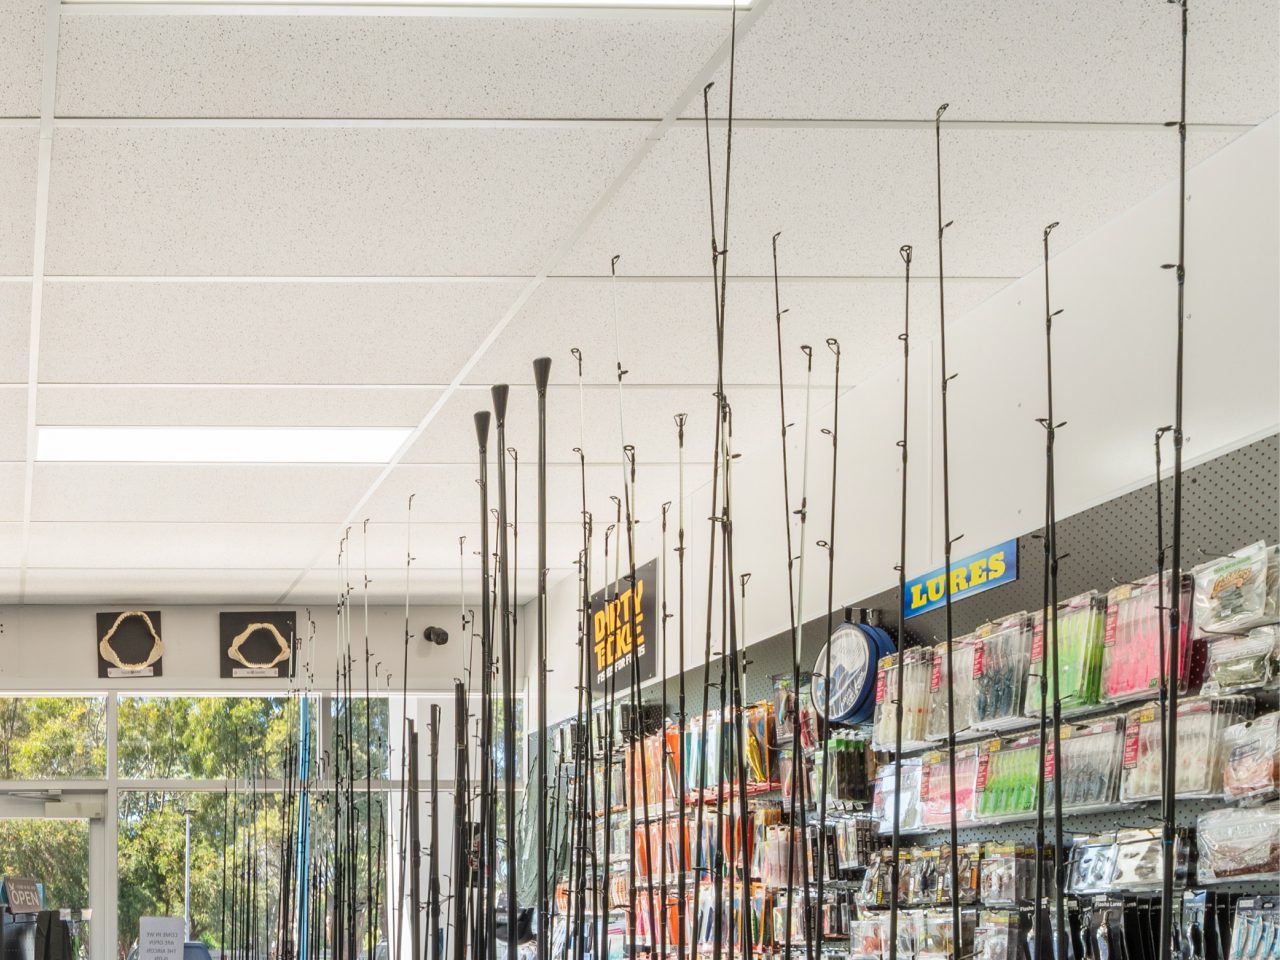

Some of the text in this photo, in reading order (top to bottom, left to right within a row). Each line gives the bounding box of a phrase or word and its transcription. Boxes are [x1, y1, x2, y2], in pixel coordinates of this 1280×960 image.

[910, 551, 1006, 609] LURES
[594, 579, 644, 643] DIRTY
[11, 890, 40, 906] OPEN
